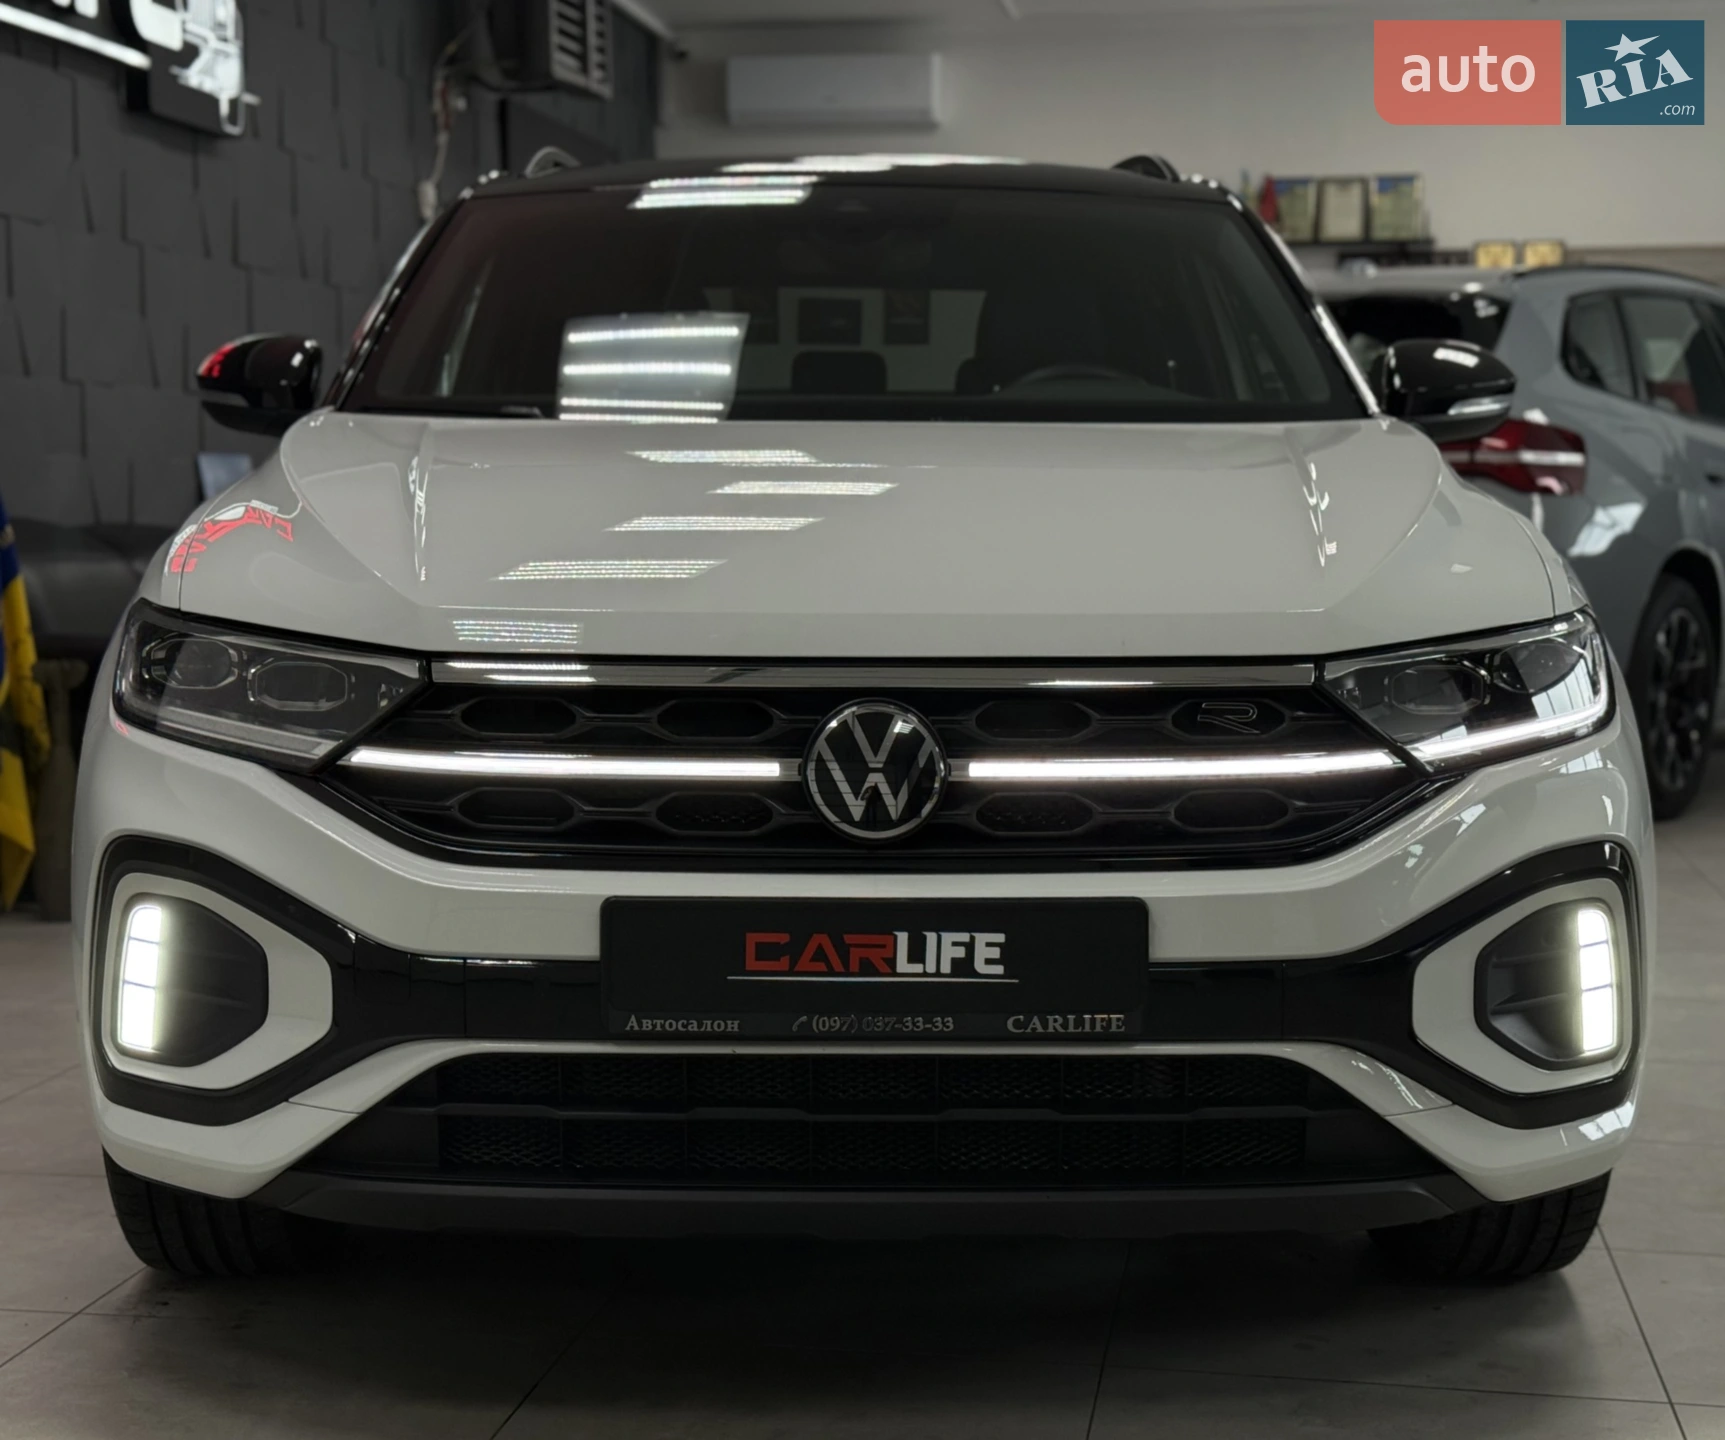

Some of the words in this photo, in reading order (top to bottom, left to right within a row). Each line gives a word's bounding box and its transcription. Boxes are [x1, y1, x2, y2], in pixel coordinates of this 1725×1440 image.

[745, 931, 1006, 975] CARLIFE
[625, 1014, 741, 1032] Автосалон
[812, 1014, 858, 1034] (097)
[862, 1016, 954, 1032] 037-33-33
[1006, 1014, 1126, 1033] CARLIFE
